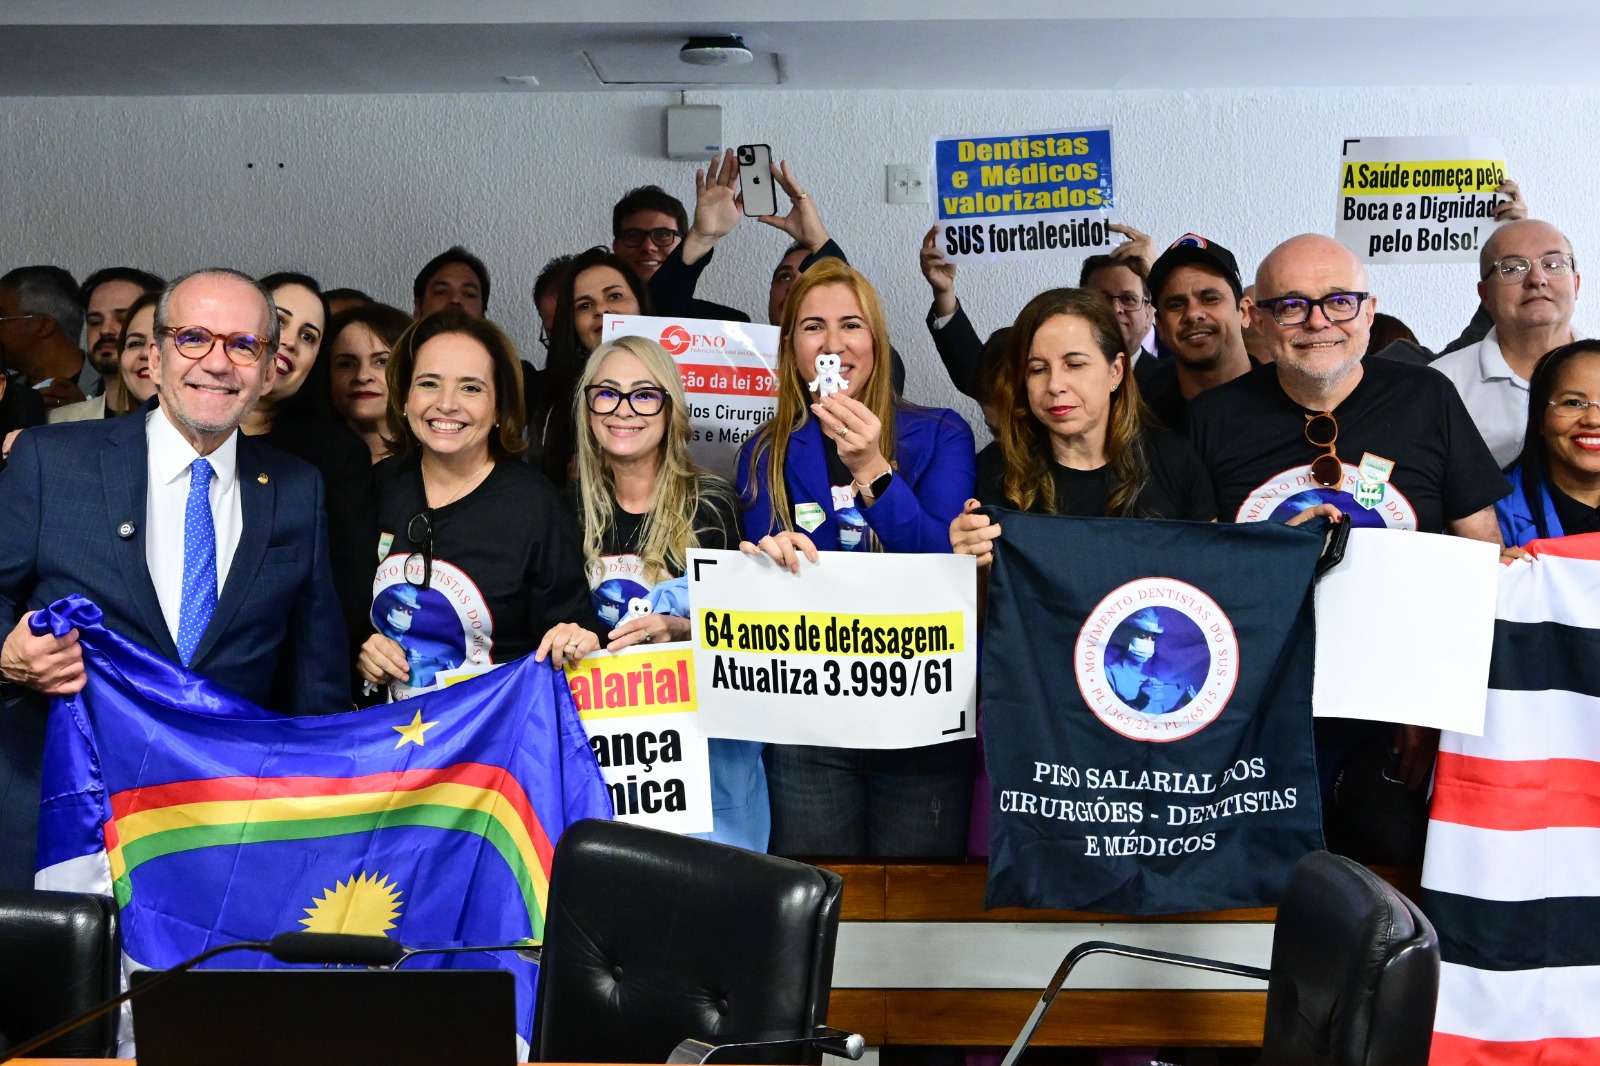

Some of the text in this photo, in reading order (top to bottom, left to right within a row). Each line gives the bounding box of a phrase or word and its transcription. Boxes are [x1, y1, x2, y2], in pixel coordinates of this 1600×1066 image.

[958, 137, 1089, 162] Dentistas
[952, 162, 1098, 189] e Médicos
[1343, 162, 1504, 193] A Saúde começa pela
[1344, 197, 1388, 221] Boca
[1393, 202, 1403, 220] e
[1406, 202, 1416, 220] a
[945, 218, 1110, 256] SUS fortalecido!
[1369, 226, 1478, 257] pelo Bolso!
[692, 334, 726, 348] FNO
[680, 372, 705, 390] ção
[710, 373, 727, 388] da
[733, 374, 751, 390] lei
[705, 430, 713, 441] e
[406, 564, 471, 605] DETISTAS
[467, 609, 482, 630] DO
[704, 611, 955, 659] 64 anos de defasagem.
[1084, 587, 1228, 677] MOVIMENTO DENTISTAS DO SUS
[473, 634, 484, 656] SUS
[570, 660, 690, 712] alarial
[712, 655, 952, 697] Atualiza 3.999/61
[1092, 687, 1217, 730] PL 1365/22 PL 765/15
[589, 729, 682, 772] ança
[1032, 757, 1266, 794] PISO SALARIAL DOS
[1000, 790, 1143, 823] CIRURGIÕES
[1167, 787, 1297, 826] DENTISTAS
[1084, 829, 1216, 856] E MÉDICOS
